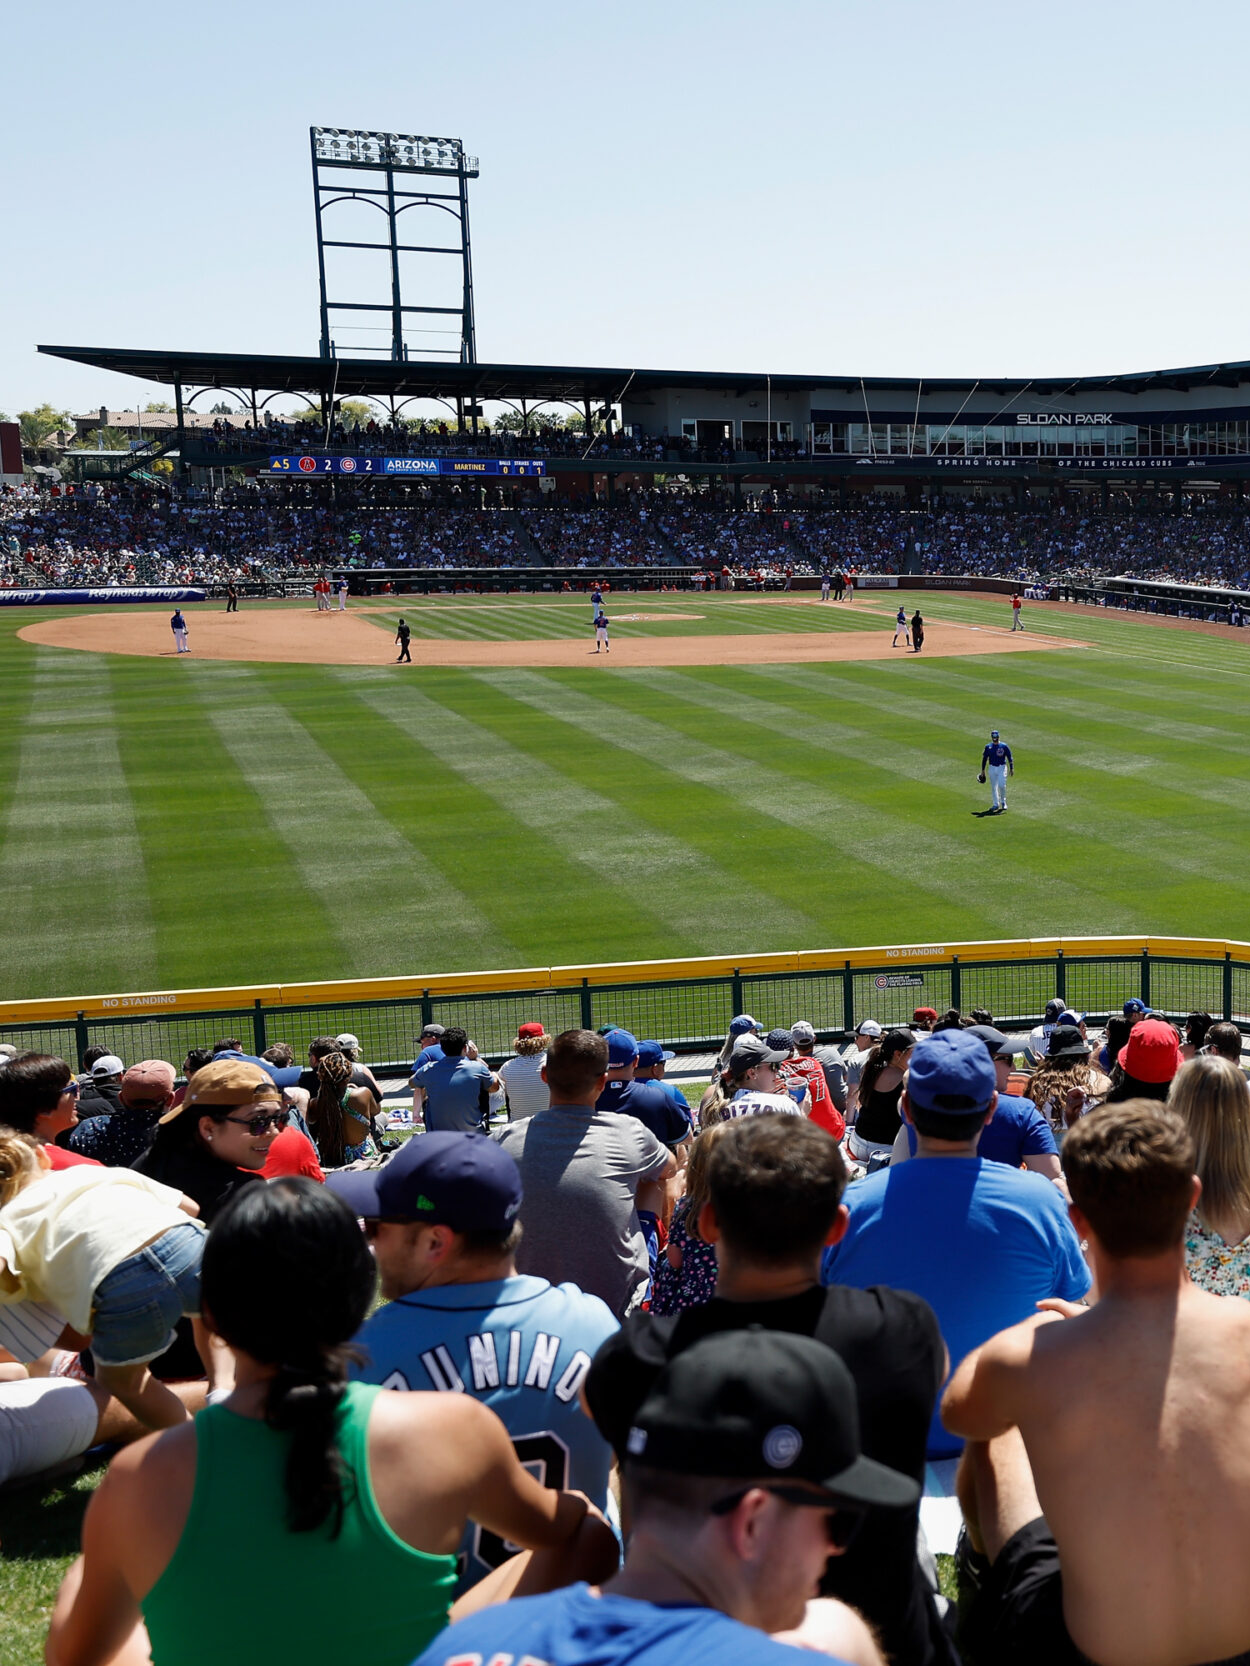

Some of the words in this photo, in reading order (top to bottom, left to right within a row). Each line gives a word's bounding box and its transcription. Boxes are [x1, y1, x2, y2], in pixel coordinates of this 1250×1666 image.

[1017, 414, 1071, 425] SLOAN
[1075, 414, 1112, 424] PARK
[283, 459, 290, 470] 5
[325, 460, 332, 471] 2
[365, 460, 372, 471] 2
[387, 460, 437, 469] ARIZONA
[454, 463, 485, 471] MARTINEZ
[503, 466, 508, 474] 0
[537, 467, 541, 475] 1
[88, 588, 144, 599] Reynolds
[145, 588, 179, 599] Wrap
[886, 949, 899, 957] NO
[901, 947, 945, 956] STANDING
[102, 998, 119, 1008] NO
[122, 995, 177, 1006] STANDING
